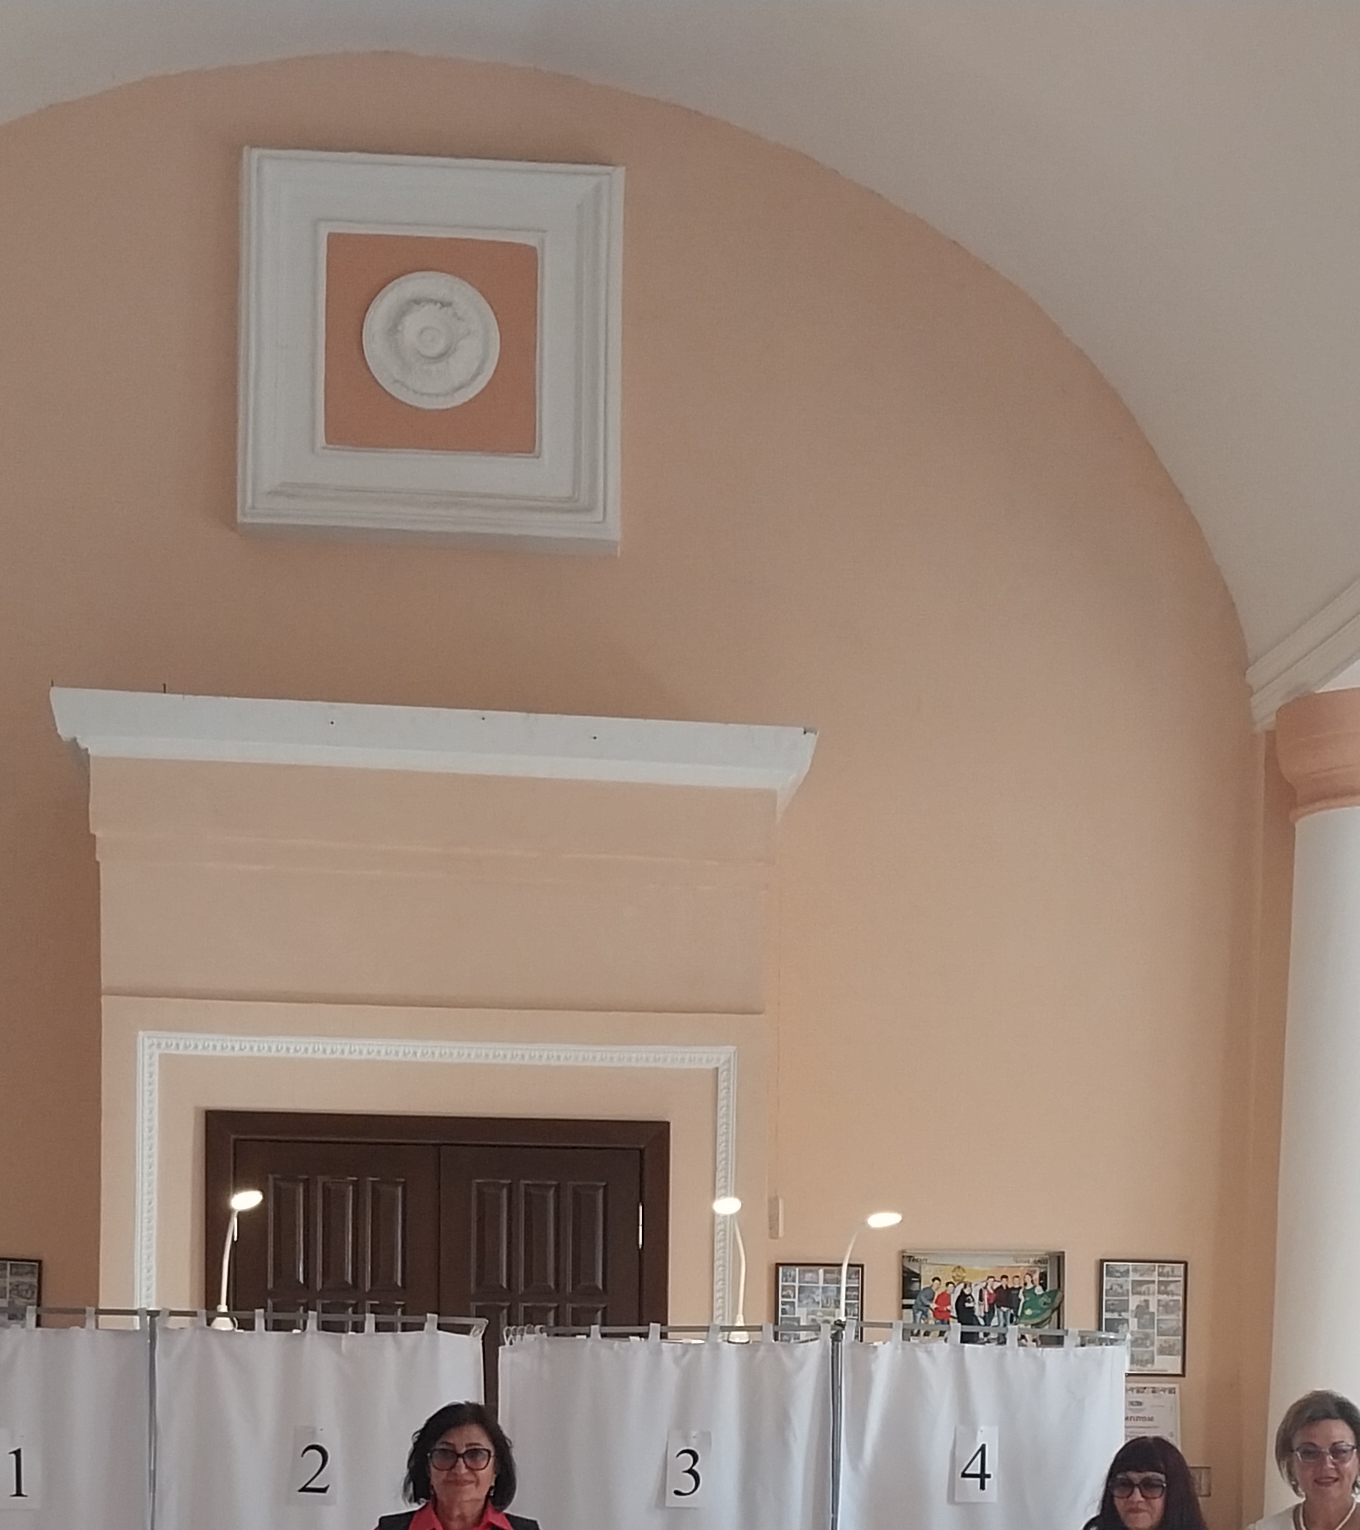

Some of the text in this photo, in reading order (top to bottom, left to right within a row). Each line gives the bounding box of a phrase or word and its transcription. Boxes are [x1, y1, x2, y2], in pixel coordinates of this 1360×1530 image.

[8, 1447, 29, 1498] 1
[297, 1443, 331, 1494] 2
[673, 1448, 702, 1497] 3
[960, 1443, 992, 1492] 4
